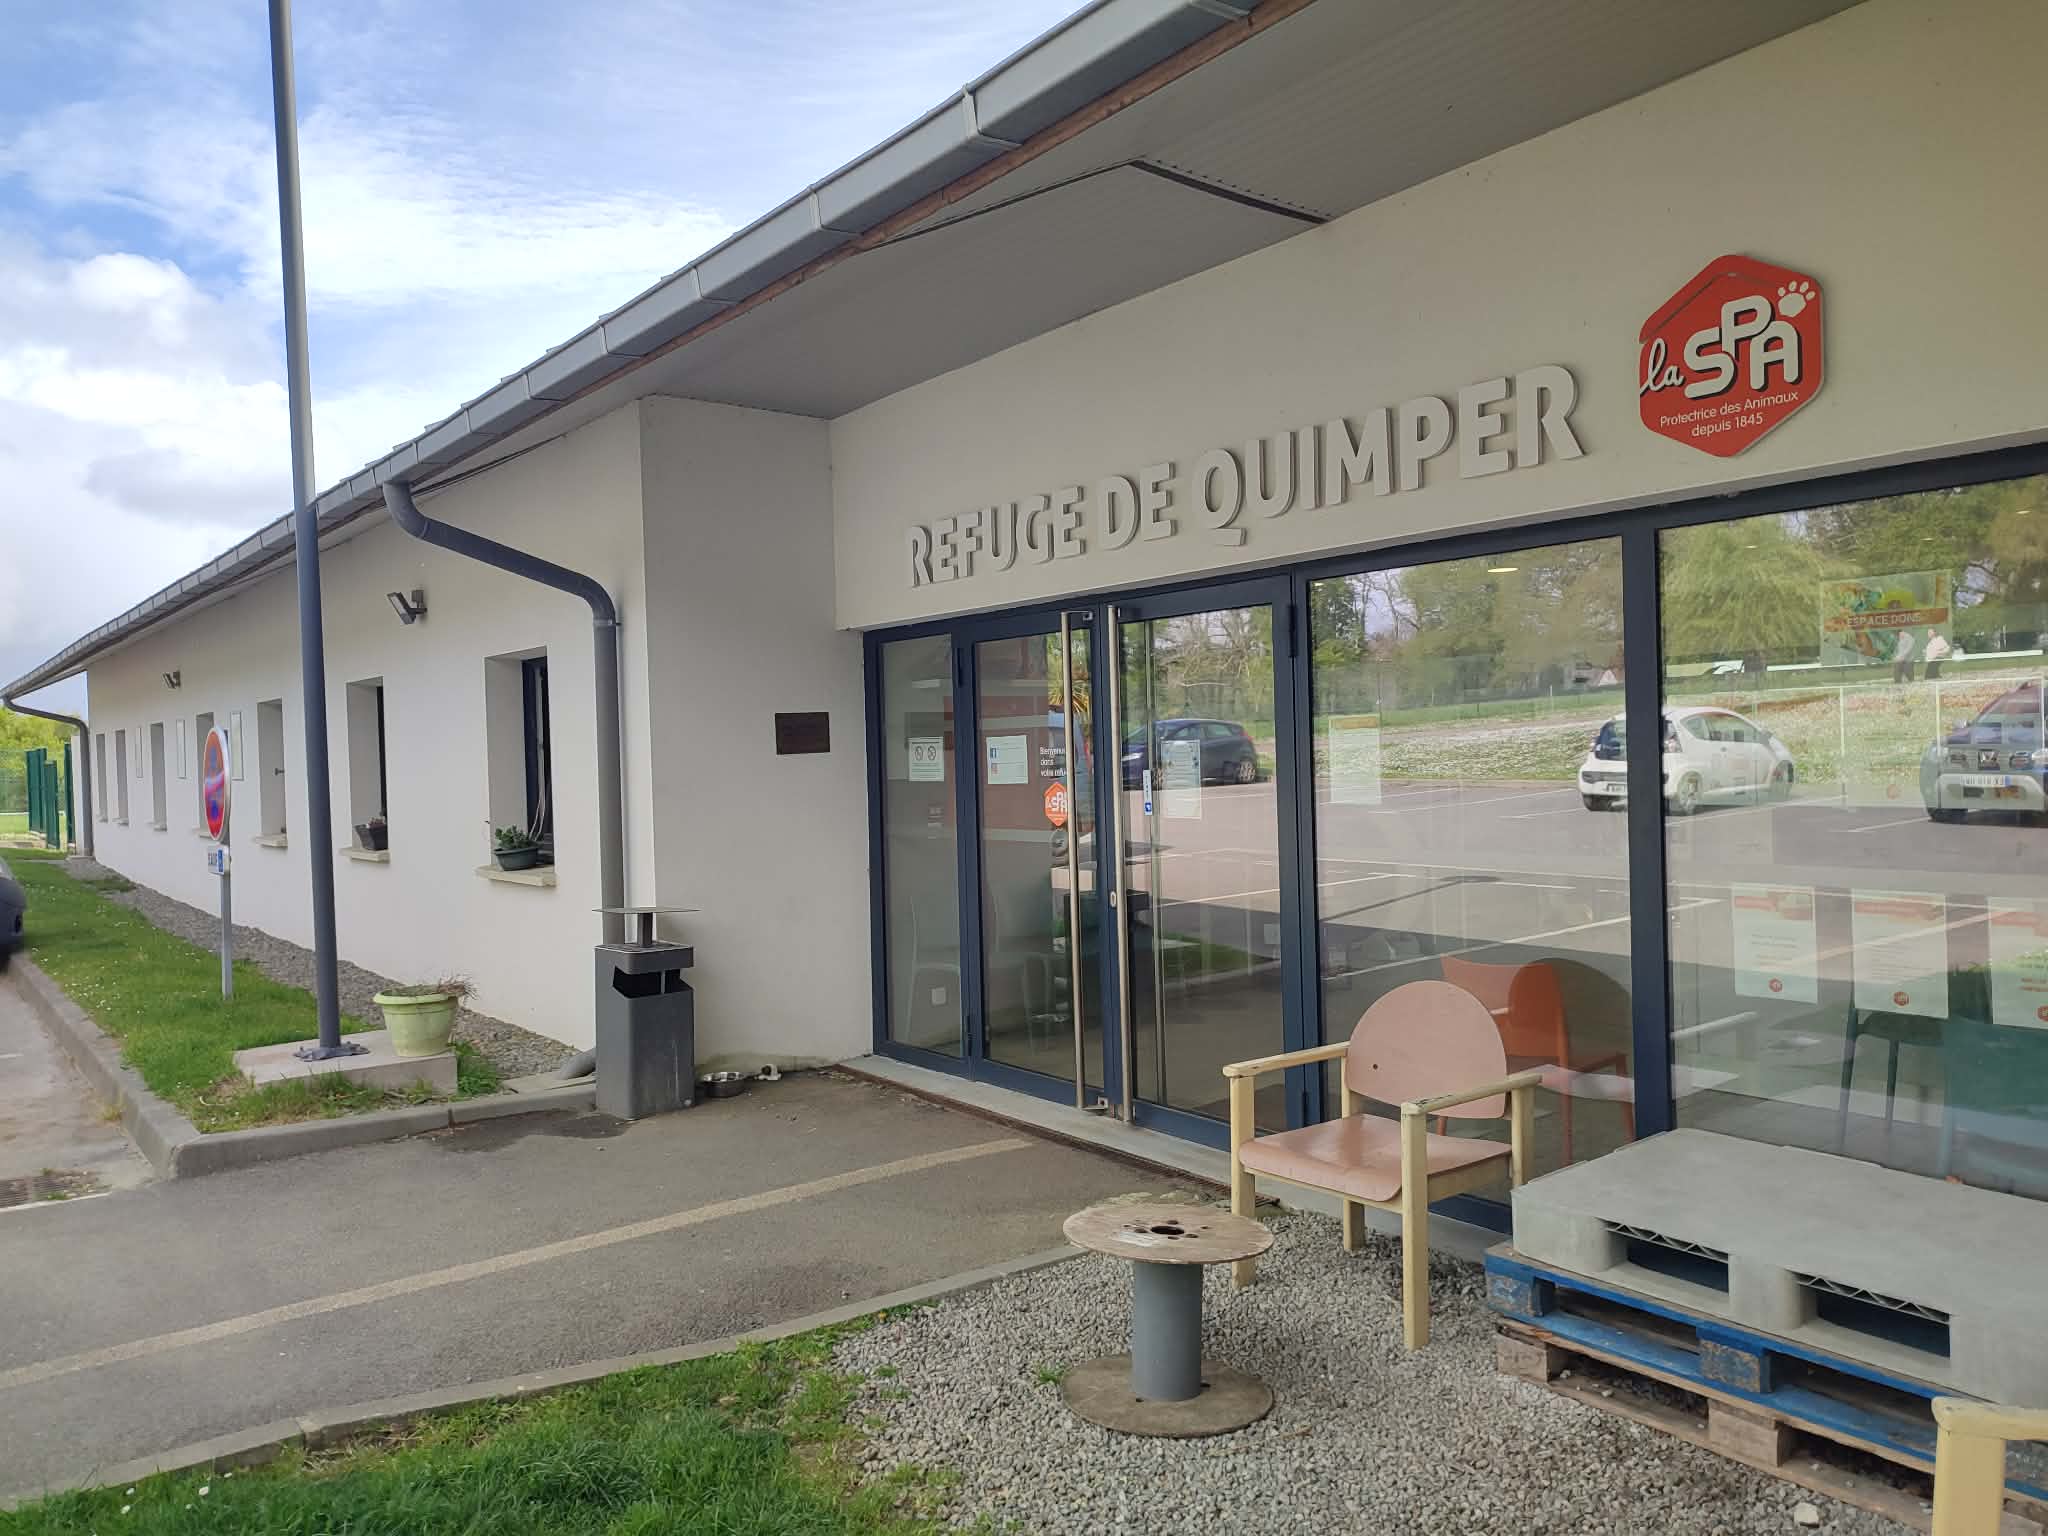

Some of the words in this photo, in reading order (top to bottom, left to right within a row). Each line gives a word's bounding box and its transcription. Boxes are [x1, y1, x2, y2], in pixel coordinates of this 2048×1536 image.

[1639, 337, 1684, 397] la
[1683, 295, 1802, 399] SPA
[1660, 406, 1717, 427] Protectrice
[1719, 402, 1741, 416] des
[1743, 391, 1799, 411] Animaux
[1691, 419, 1732, 438] depuis
[1735, 412, 1764, 429] 1845
[910, 485, 1085, 588] REFUGE
[1099, 461, 1178, 551] DE
[1193, 363, 1587, 547] QUIMPER
